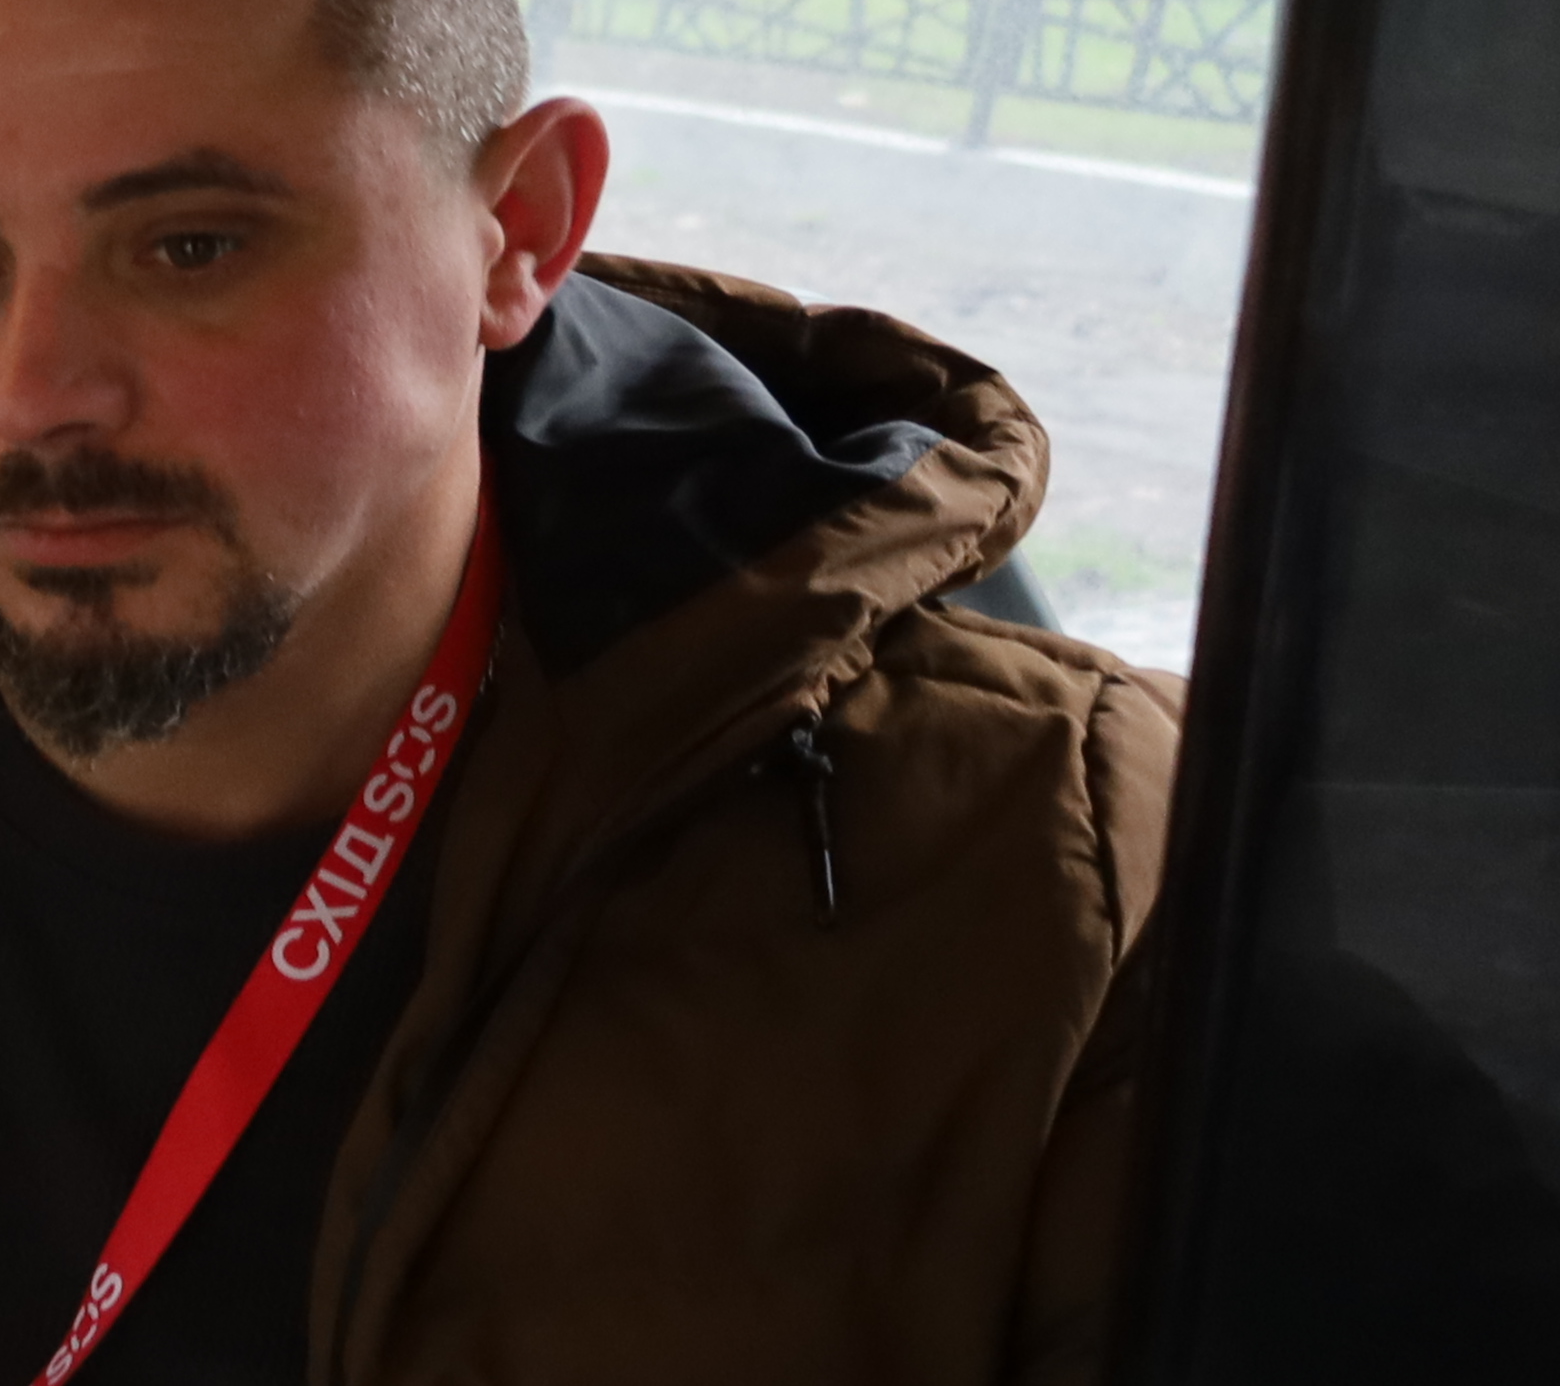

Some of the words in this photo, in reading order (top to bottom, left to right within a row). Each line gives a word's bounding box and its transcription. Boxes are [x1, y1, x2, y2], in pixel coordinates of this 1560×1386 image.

[272, 822, 395, 981] СХІД
[363, 684, 459, 823] SOS
[46, 1262, 123, 1386] SOS
